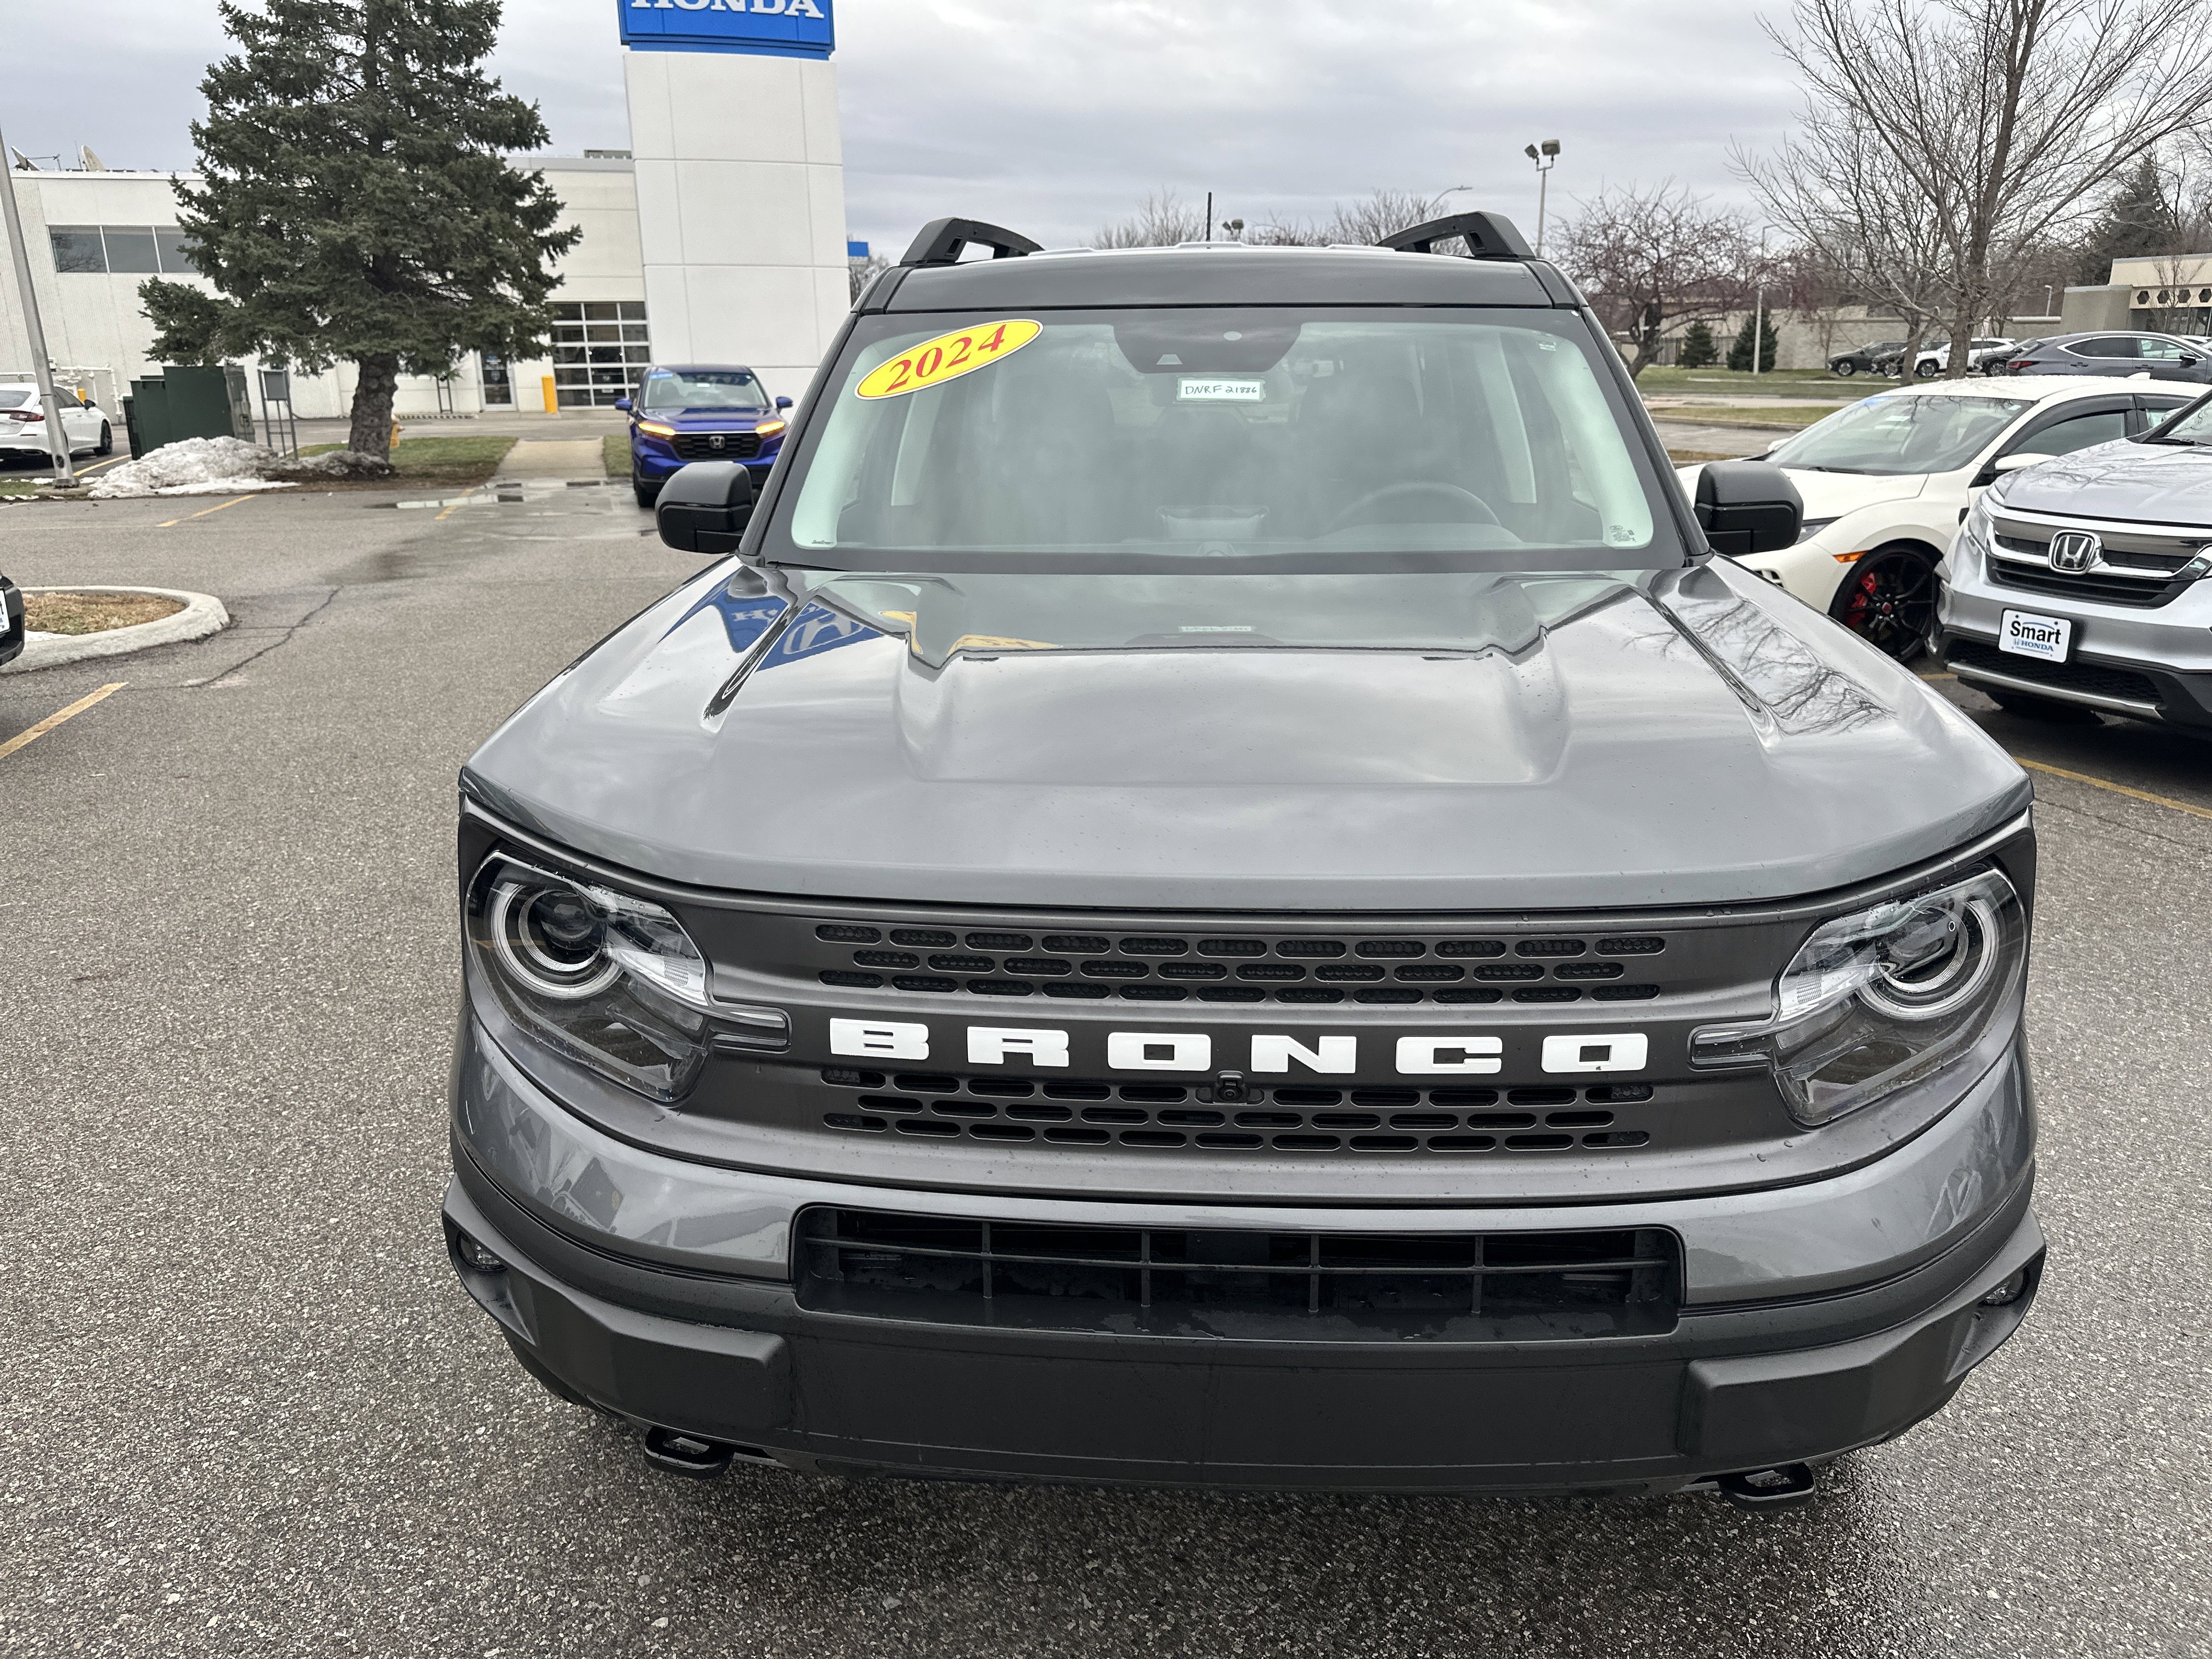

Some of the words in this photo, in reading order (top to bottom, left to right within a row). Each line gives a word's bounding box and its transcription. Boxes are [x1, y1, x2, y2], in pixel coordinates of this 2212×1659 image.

[885, 324, 1007, 393] 2024
[1185, 385, 1222, 394] DNRF
[2010, 620, 2061, 645] Smart
[2021, 640, 2055, 652] HONDA
[829, 1017, 1647, 1075] BRONCO
